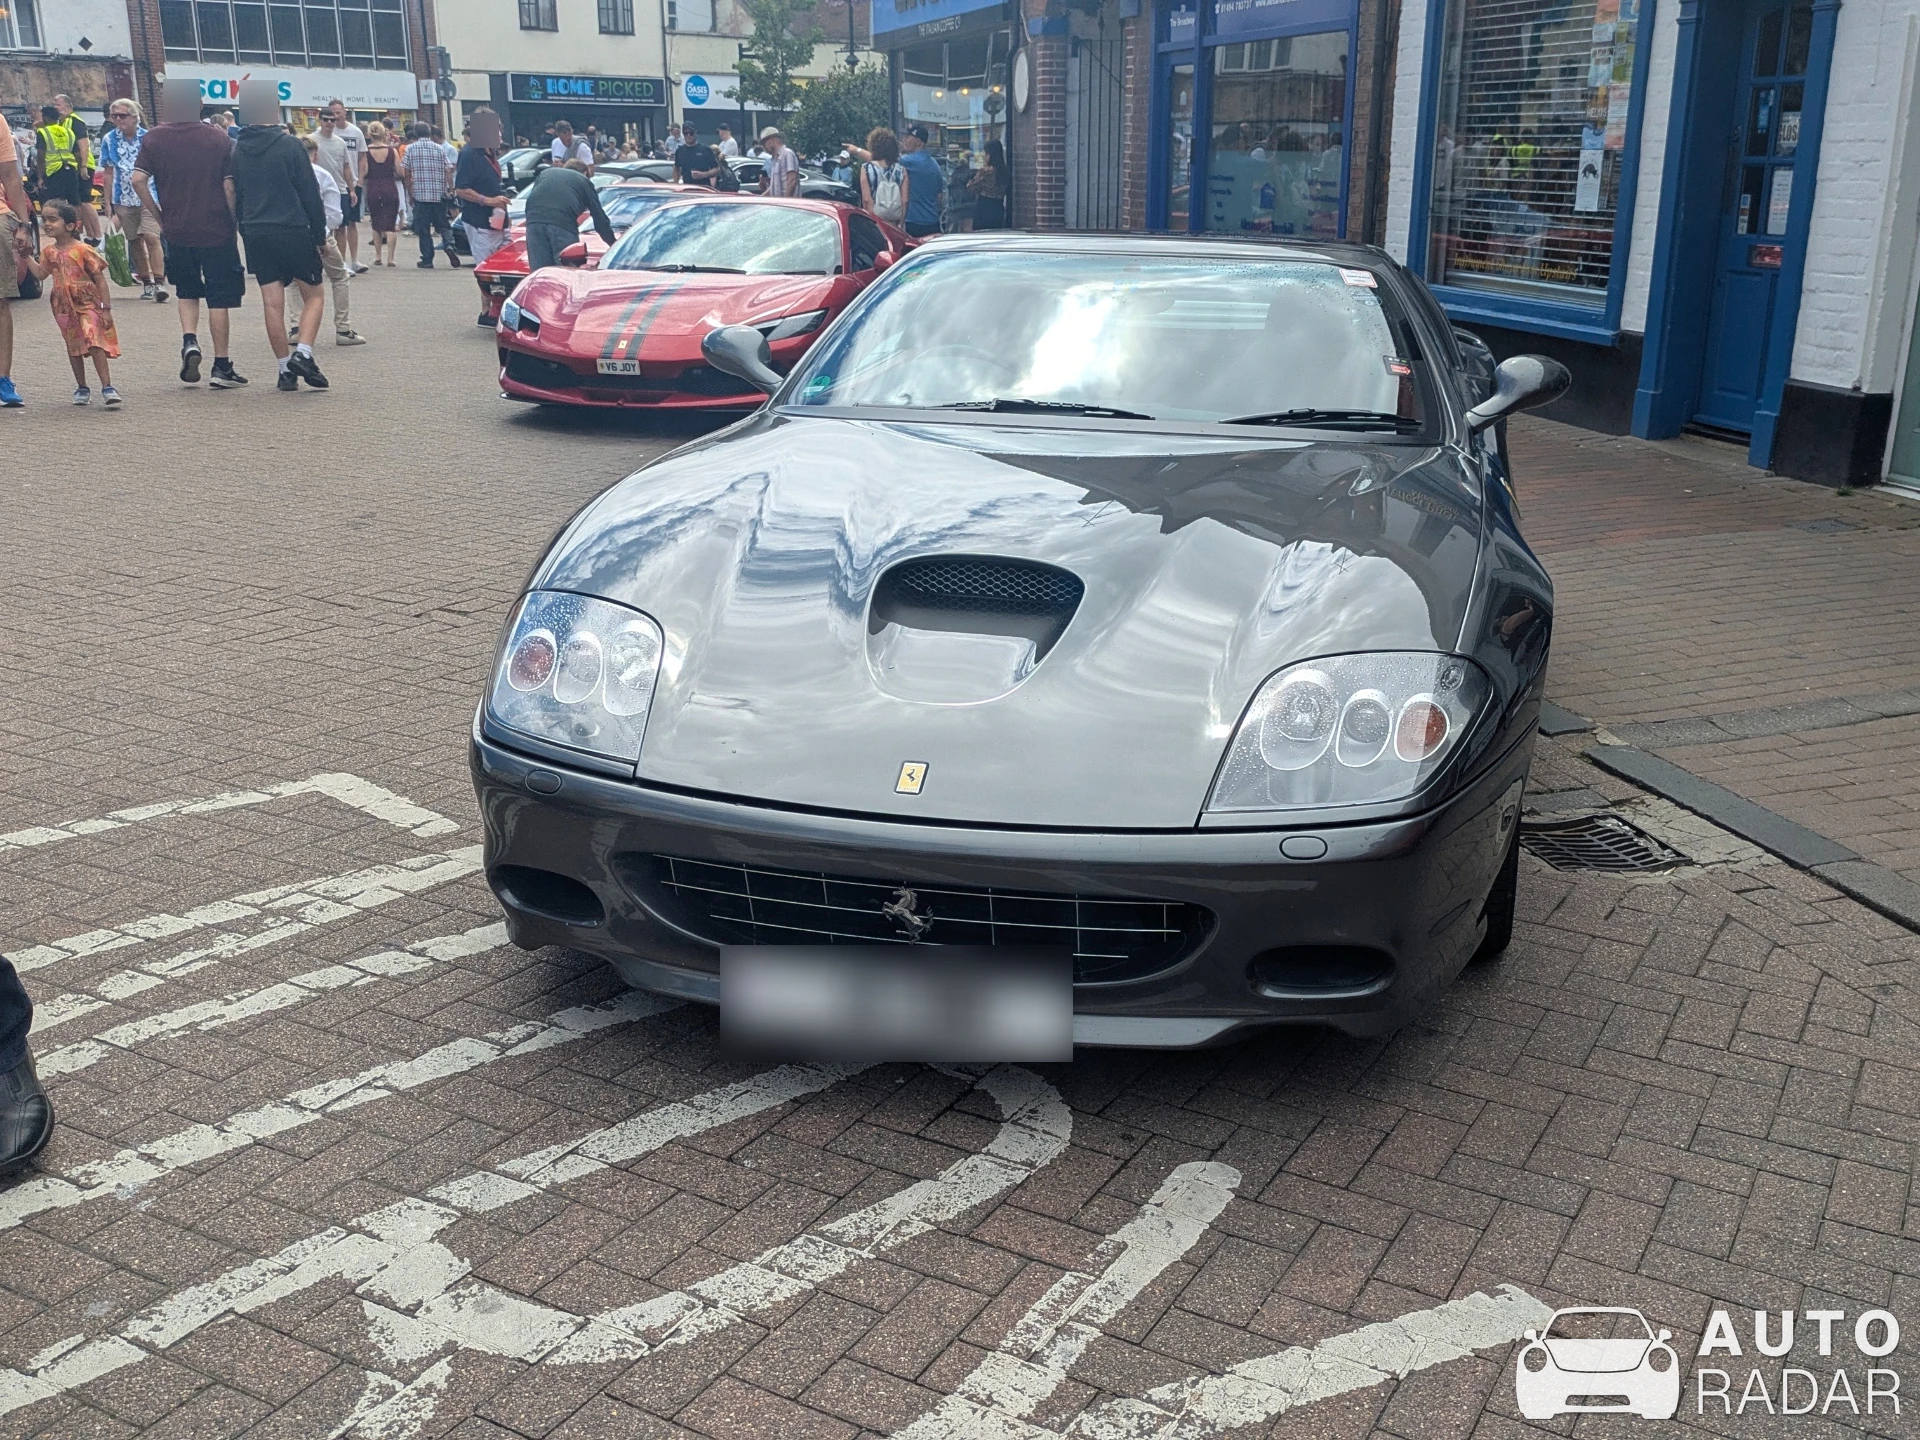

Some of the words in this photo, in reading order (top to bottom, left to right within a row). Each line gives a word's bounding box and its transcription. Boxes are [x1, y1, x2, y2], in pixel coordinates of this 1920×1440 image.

[1176, 17, 1195, 27] Broadway
[546, 78, 595, 96] HOME
[598, 80, 654, 97] PICKED
[687, 85, 708, 94] OASIS
[605, 362, 618, 371] V6
